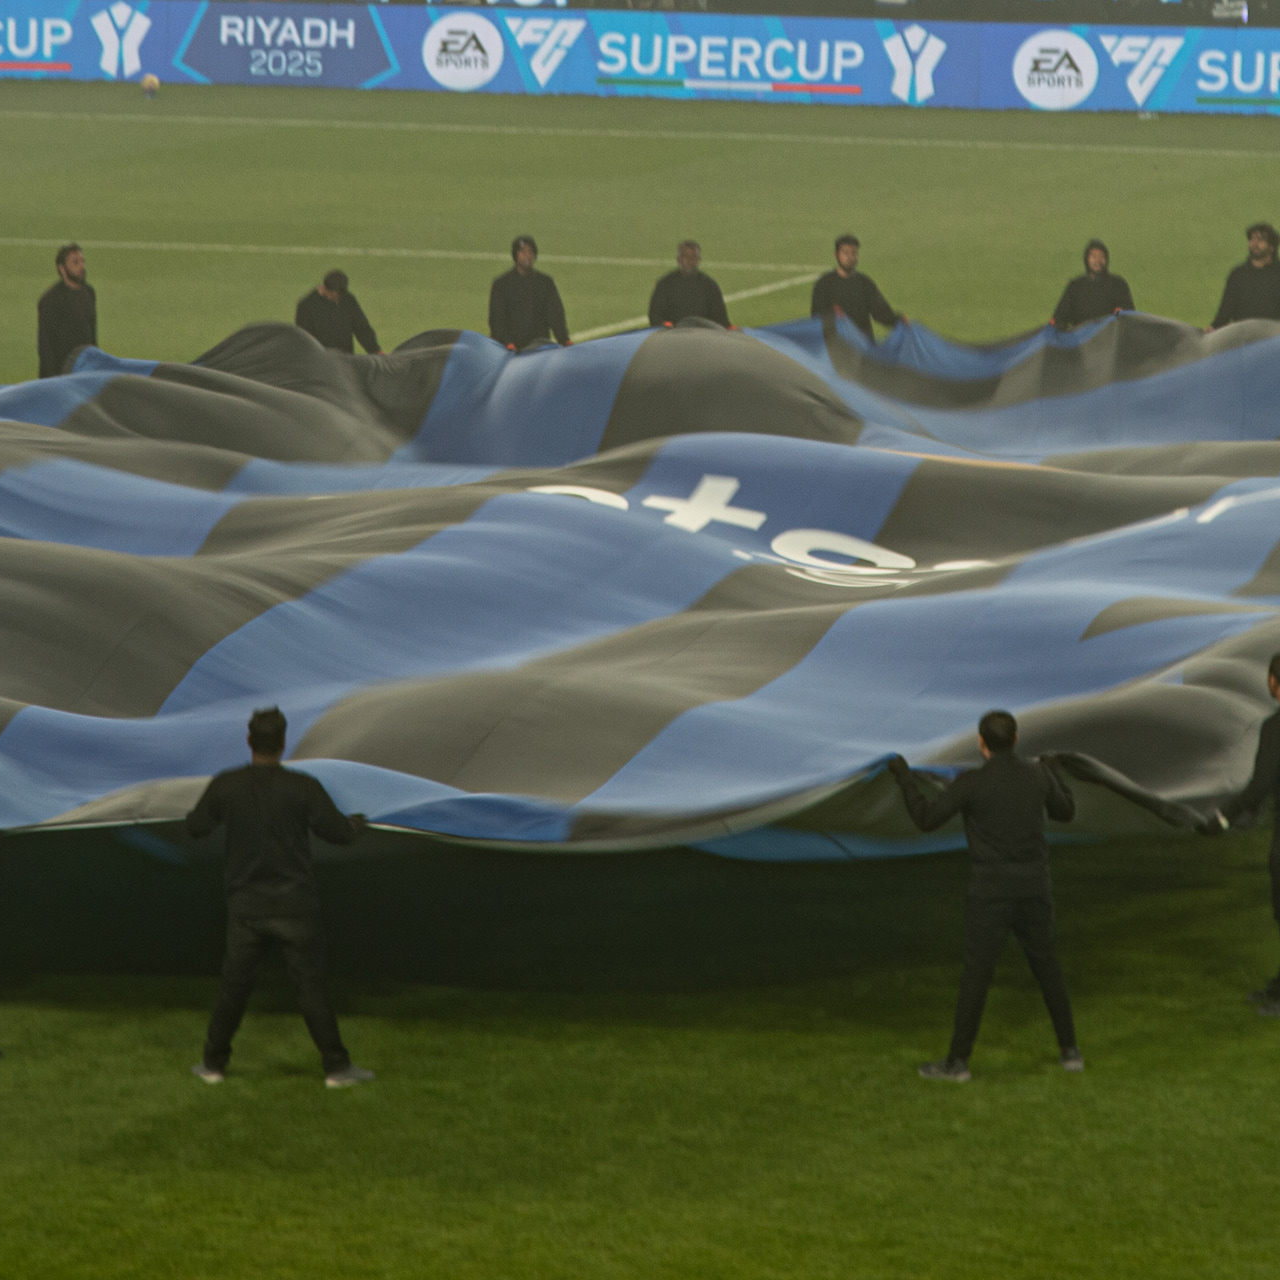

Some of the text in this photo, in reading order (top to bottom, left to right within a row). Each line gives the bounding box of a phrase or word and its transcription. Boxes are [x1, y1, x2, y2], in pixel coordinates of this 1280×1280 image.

[220, 15, 355, 49] RIYADH
[439, 29, 487, 54] EA
[250, 48, 322, 78] 2025
[504, 18, 865, 88] FC SUPERCUP
[1030, 48, 1081, 74] EA
[1099, 35, 1185, 108] FC
